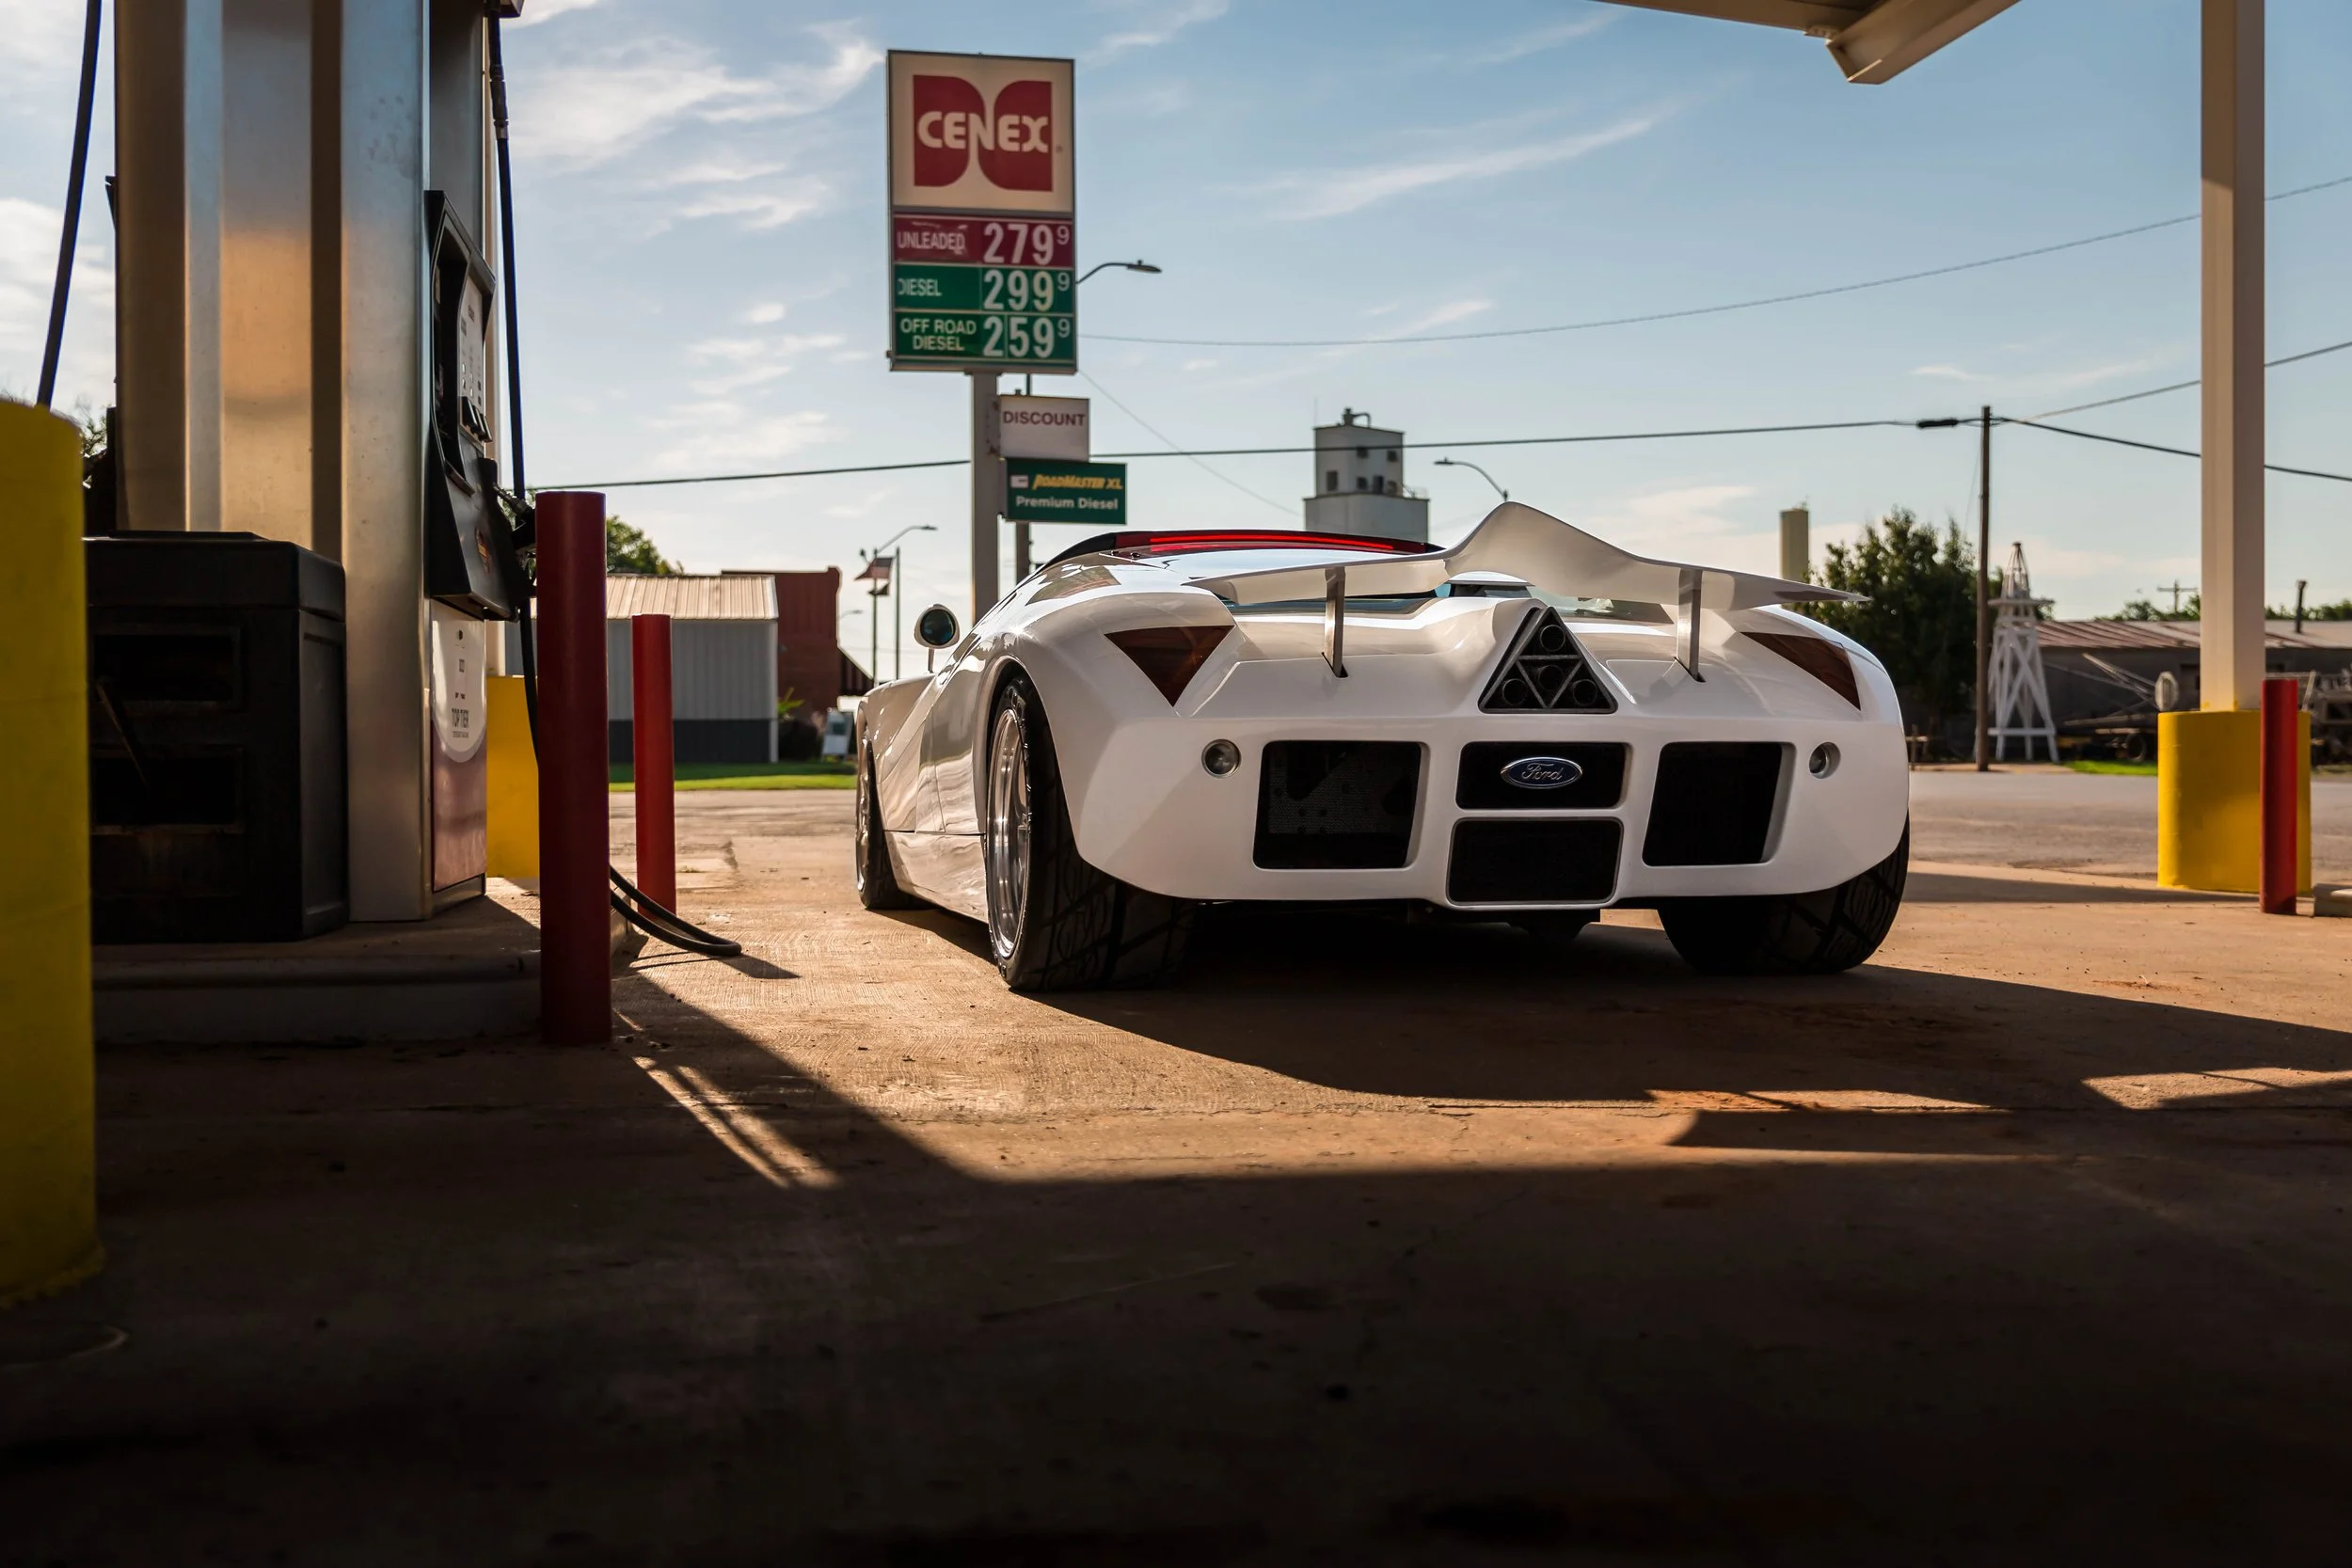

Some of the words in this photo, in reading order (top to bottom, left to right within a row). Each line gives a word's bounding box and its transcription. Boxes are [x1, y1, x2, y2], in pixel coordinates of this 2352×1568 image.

[917, 111, 1049, 153] CENEX
[898, 230, 966, 252] UNLEADED
[900, 318, 930, 334] OFF
[934, 319, 977, 335] ROAD
[913, 335, 965, 351] DIESEL
[1003, 411, 1086, 426] DISCOUNT
[1106, 478, 1123, 490] XL
[1016, 496, 1074, 509] Premium
[1077, 497, 1119, 510] Diesel
[1521, 762, 1563, 781] Ford
